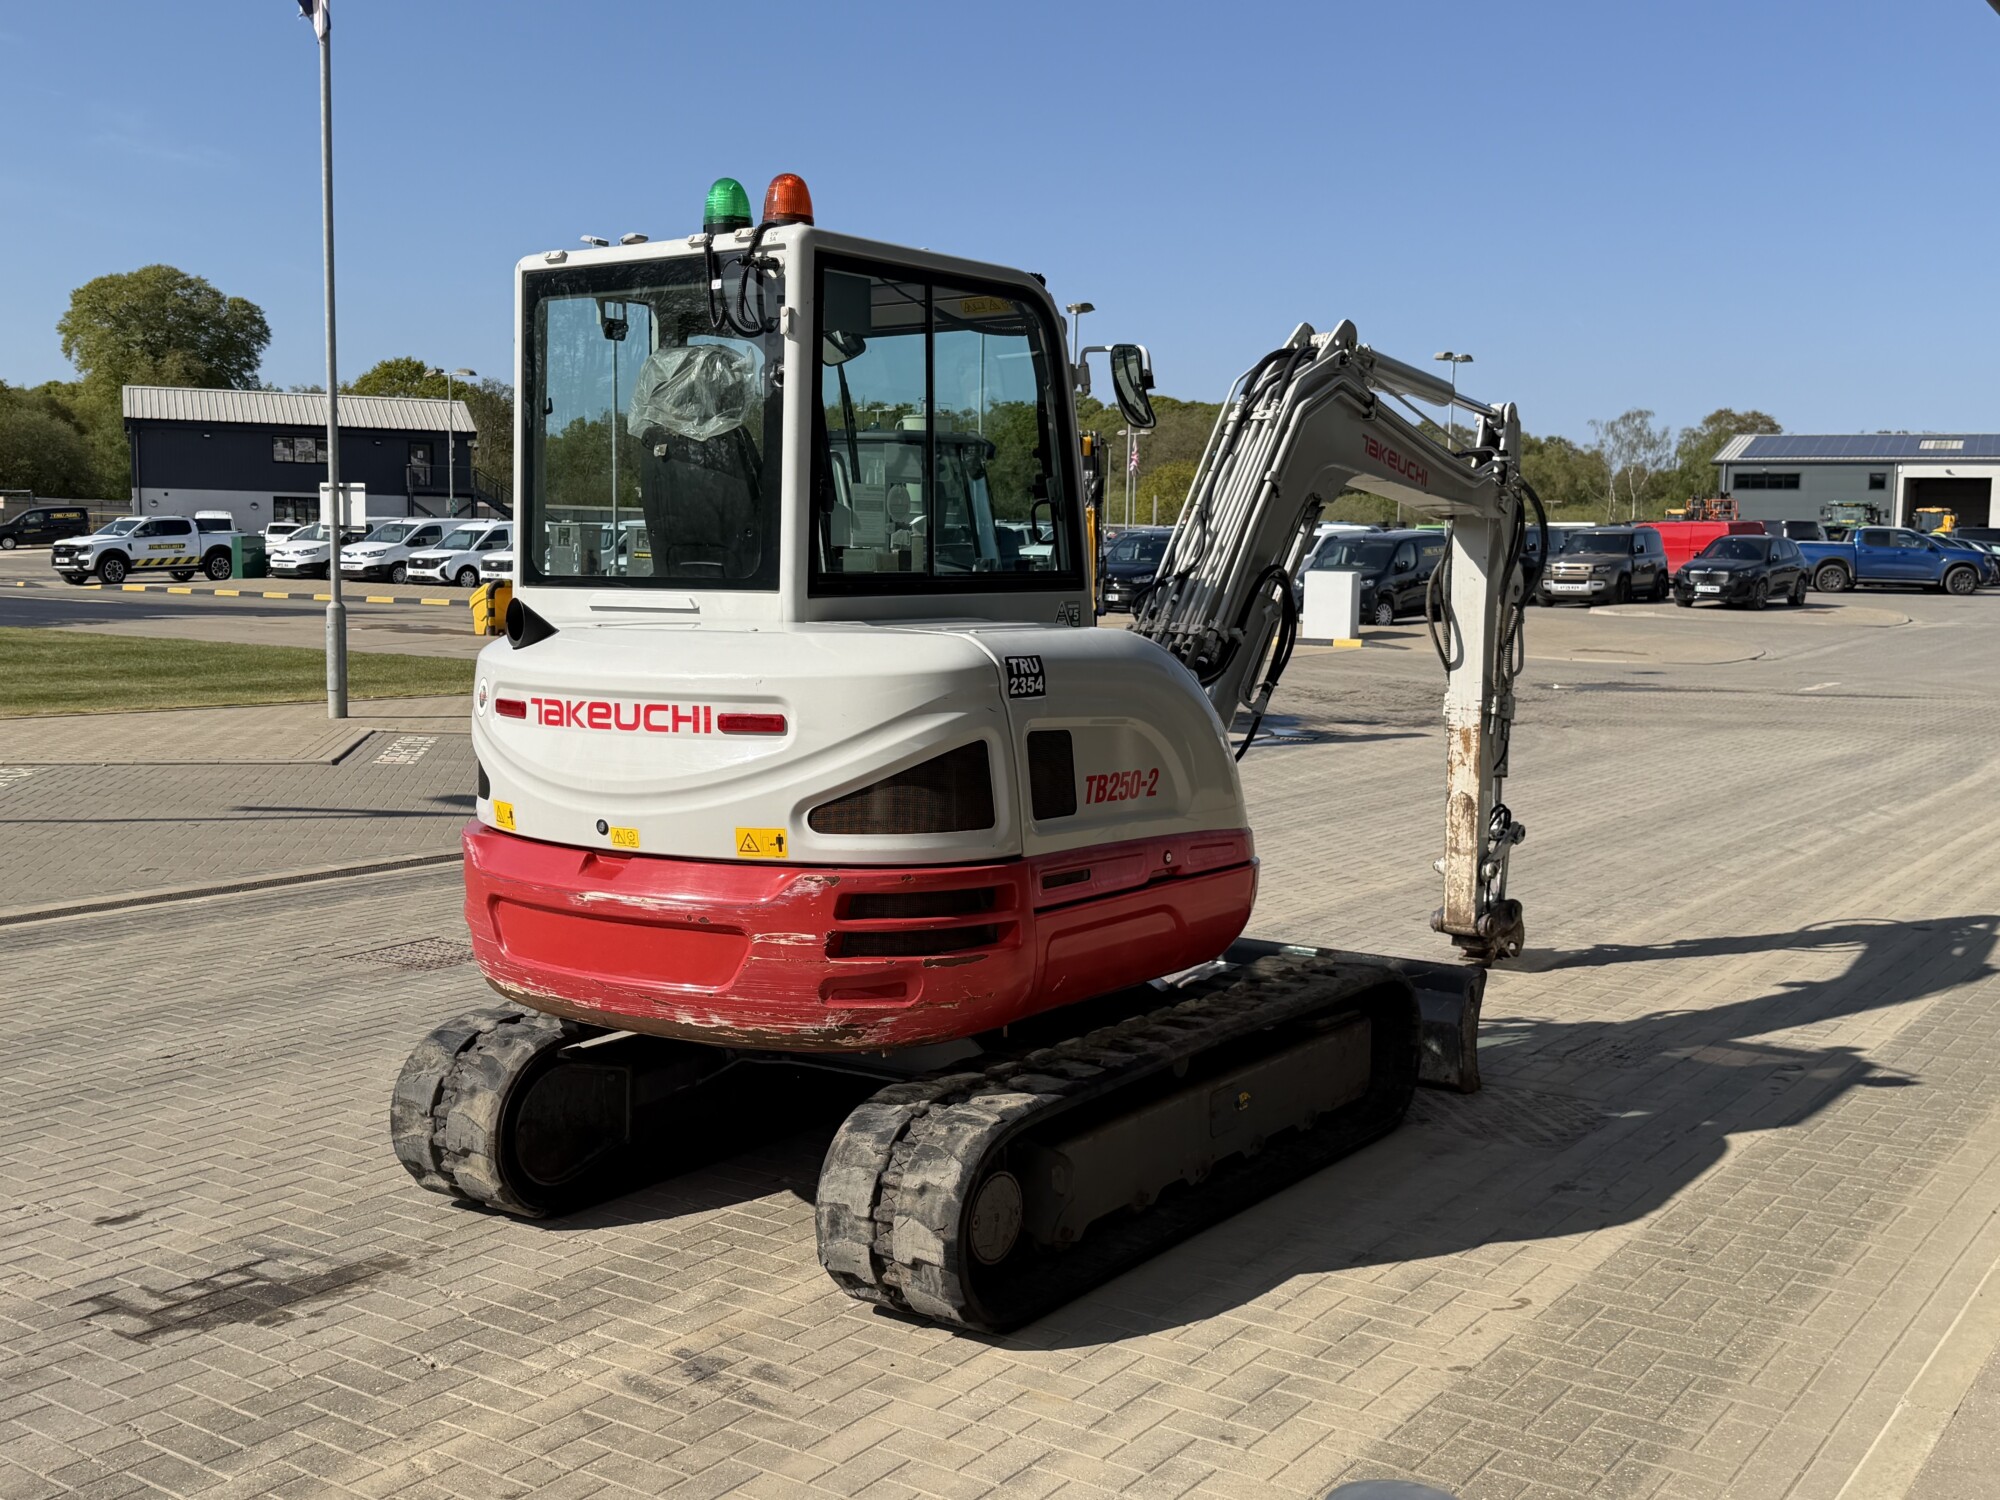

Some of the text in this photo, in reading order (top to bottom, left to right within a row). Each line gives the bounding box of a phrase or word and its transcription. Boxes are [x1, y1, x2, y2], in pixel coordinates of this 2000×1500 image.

[1362, 434, 1429, 488] TAKEUCHI
[1008, 657, 1040, 675] TRU
[1010, 675, 1044, 695] 2354
[530, 697, 712, 734] TAKEUCHI
[1085, 767, 1160, 805] TB250-2
